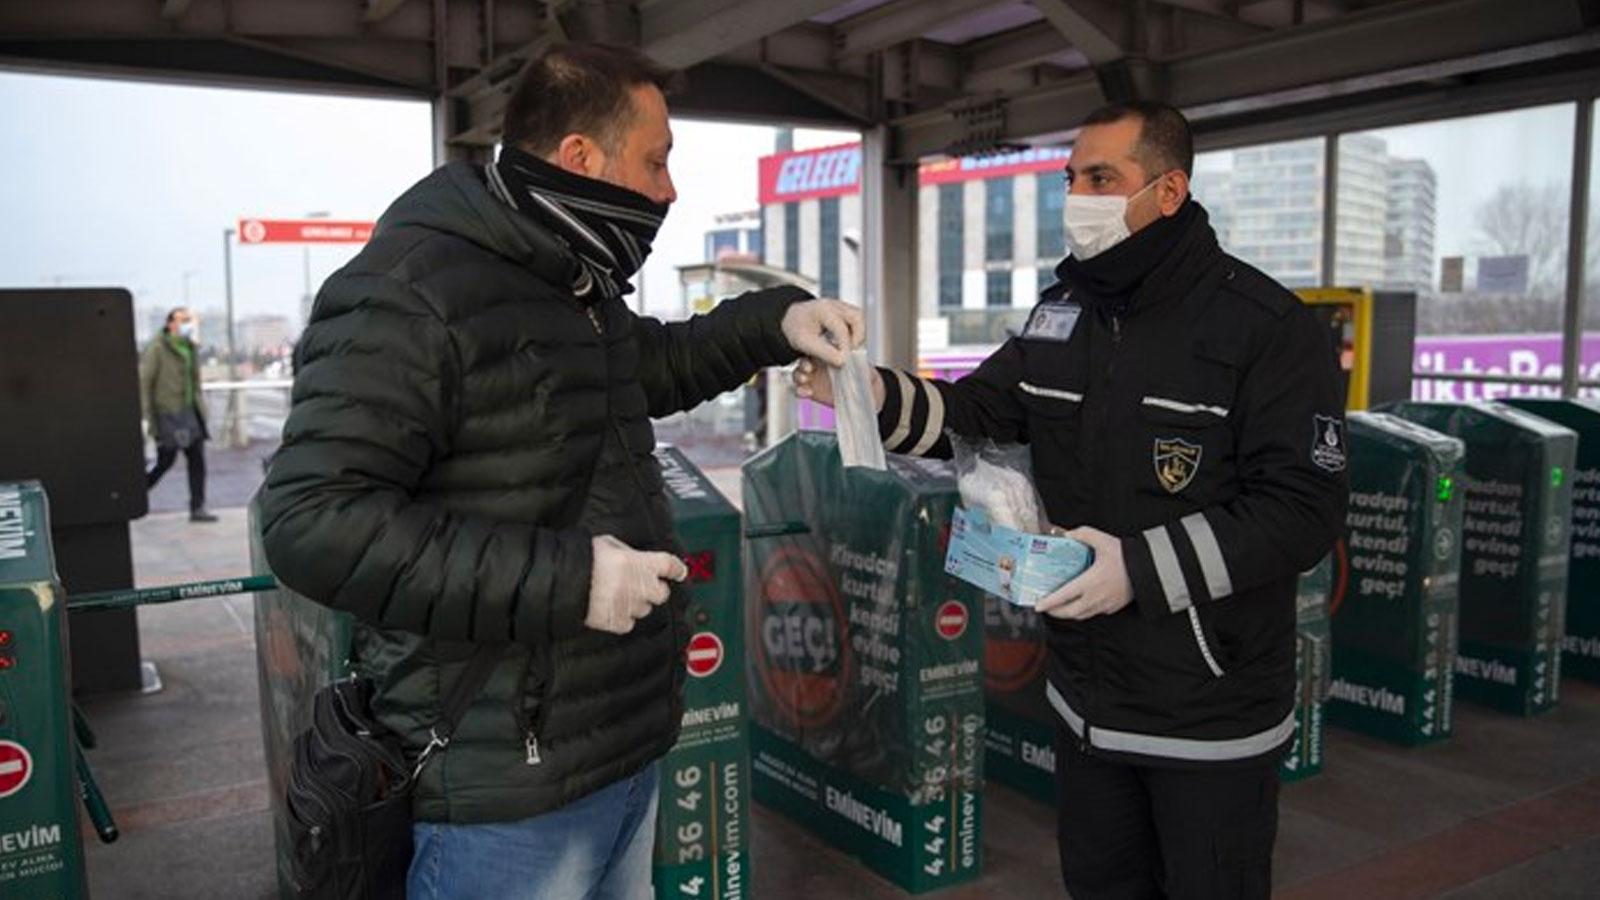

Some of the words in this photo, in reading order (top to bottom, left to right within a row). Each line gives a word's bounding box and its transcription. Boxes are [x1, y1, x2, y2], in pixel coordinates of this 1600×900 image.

[1349, 530, 1409, 554] kendi
[830, 544, 898, 577] Kiradan
[1351, 553, 1408, 576] evine
[1360, 577, 1405, 600] geç!
[850, 602, 900, 635] kendi
[763, 614, 836, 672] GEÇ!
[853, 633, 901, 666] evine
[924, 714, 947, 757] 46
[675, 765, 702, 811] 46
[825, 785, 903, 848] EMİNEVİM
[0, 824, 61, 852] EVİM
[677, 821, 704, 865] 36
[924, 815, 945, 876] 444
